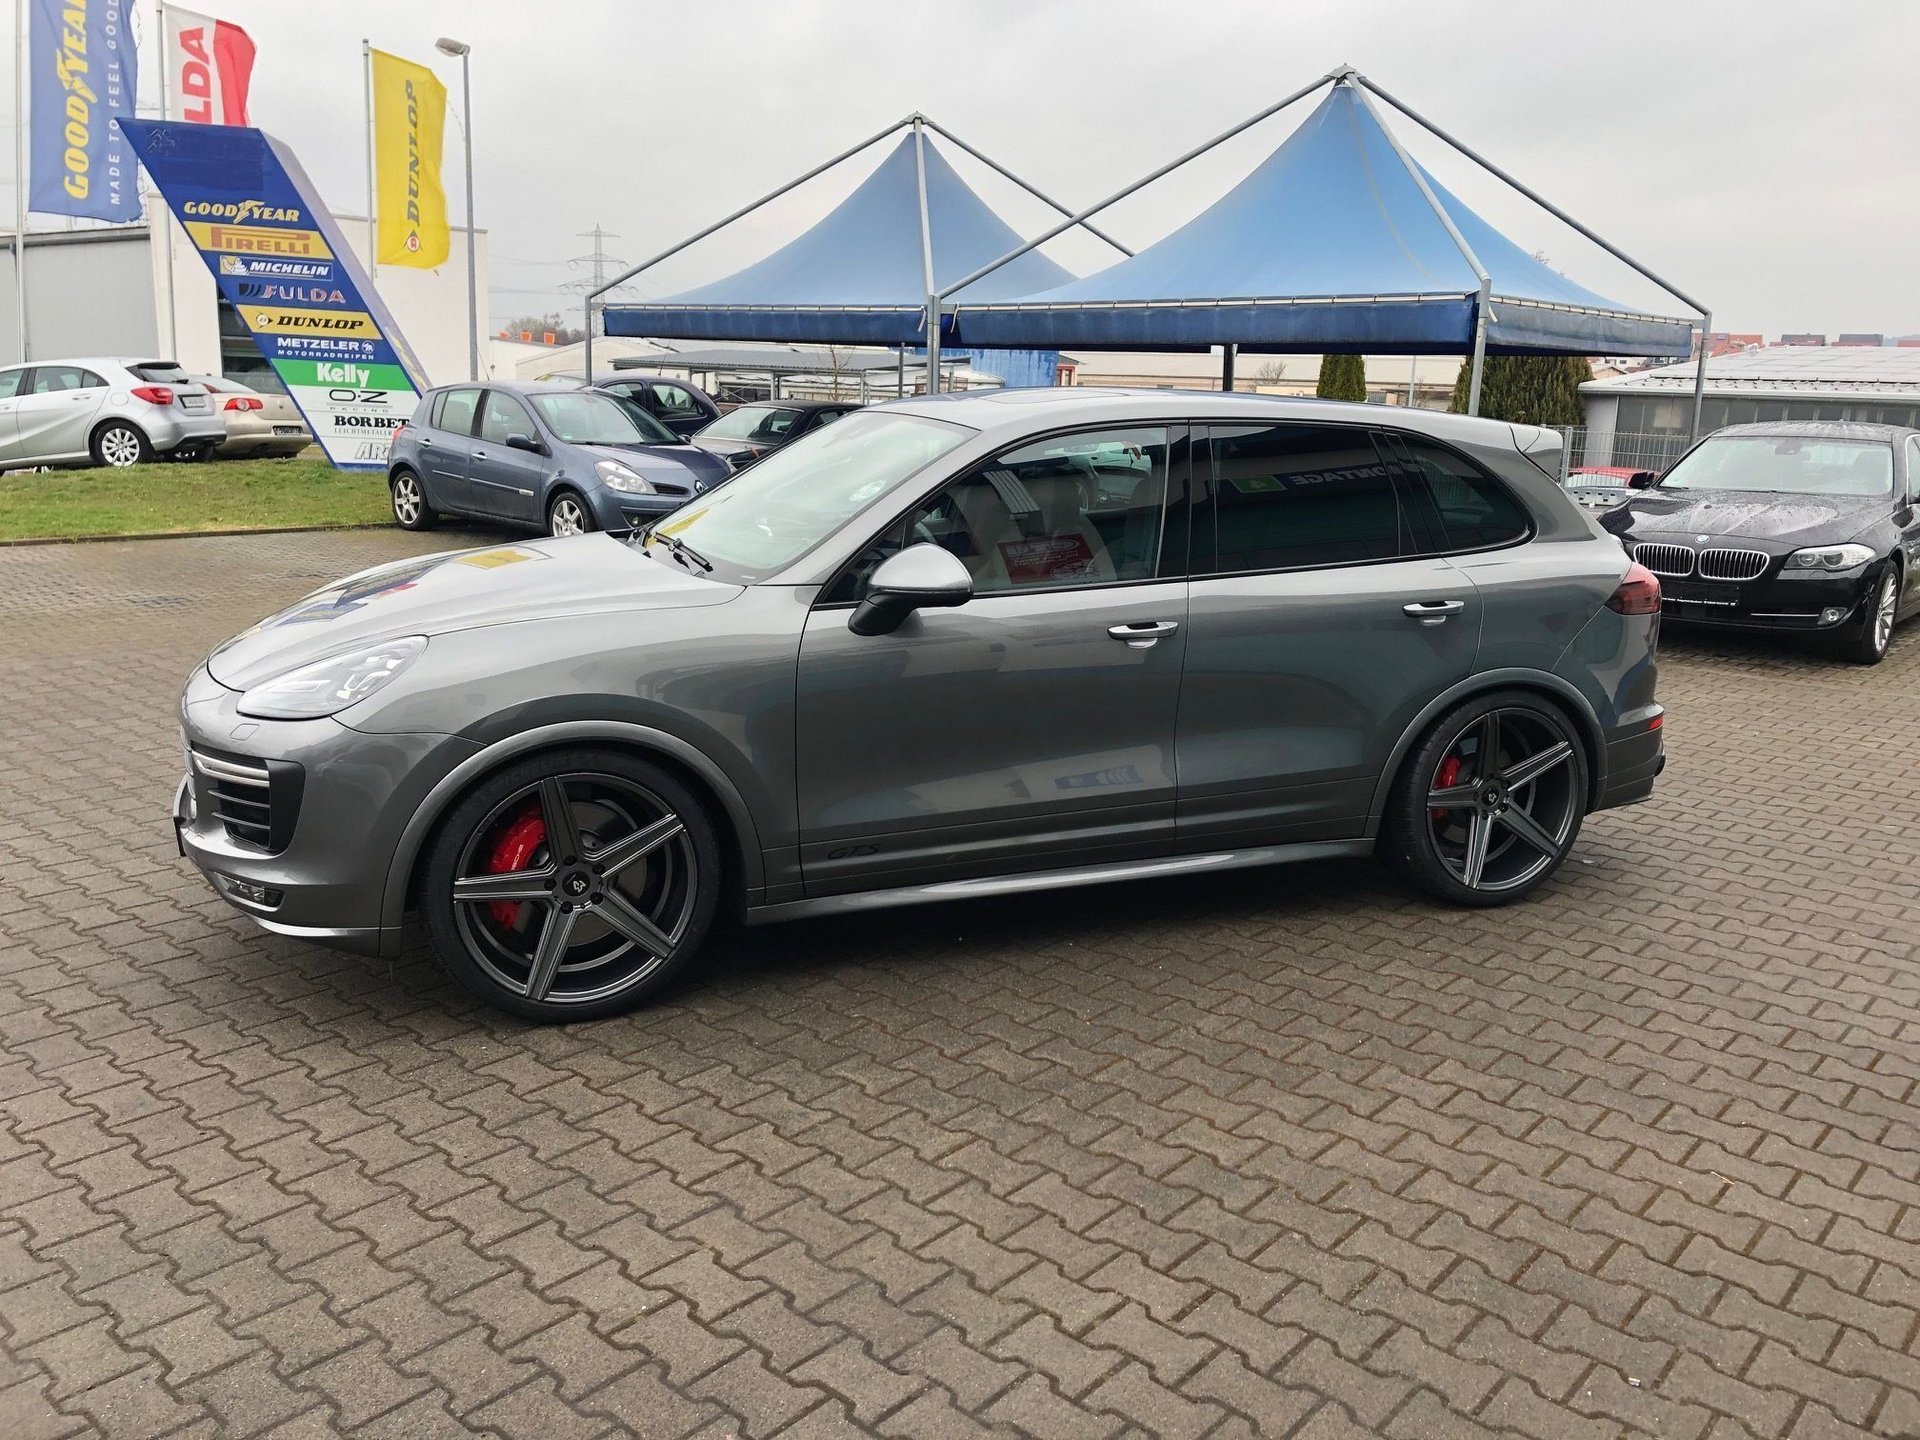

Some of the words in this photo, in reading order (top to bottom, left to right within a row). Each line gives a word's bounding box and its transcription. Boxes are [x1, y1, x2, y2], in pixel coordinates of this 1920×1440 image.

[108, 61, 121, 107] FEEL
[108, 118, 121, 147] TO
[109, 154, 121, 205] MADE
[183, 199, 300, 224] GOODYEAR
[210, 225, 311, 255] PIRELLI
[250, 261, 330, 277] MICHELIN
[261, 284, 346, 304] FULDA
[277, 315, 365, 330] DUNLOP
[277, 337, 360, 351] METZELER
[277, 349, 374, 360] MOTORRADREIFEN
[317, 362, 370, 388] Kelly
[329, 406, 390, 414] RACING
[334, 415, 410, 429] BORBET
[827, 843, 880, 861] GTS
